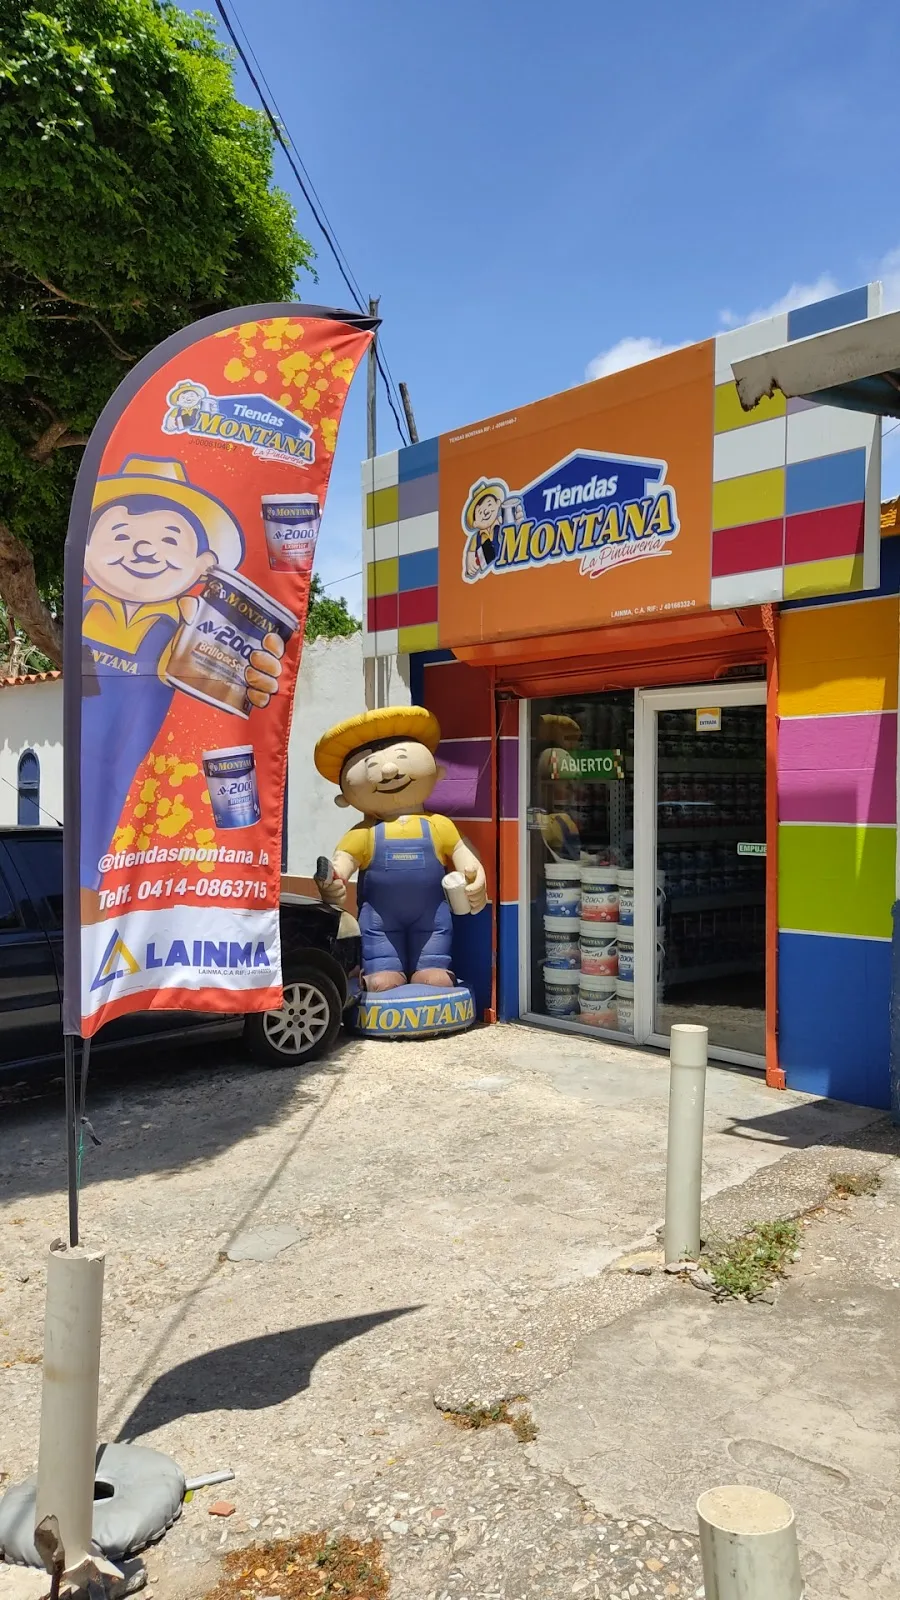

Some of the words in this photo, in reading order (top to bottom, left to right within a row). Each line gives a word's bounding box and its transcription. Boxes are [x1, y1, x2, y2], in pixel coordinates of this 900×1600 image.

[234, 403, 285, 427] Tiendas
[191, 411, 314, 461] MONTANA
[542, 475, 619, 512] Tiendas
[276, 508, 315, 516] MONTANA
[496, 493, 674, 567] MONTANA
[581, 555, 598, 572] La
[199, 642, 224, 660] Brillo
[560, 756, 613, 773] ABIERTO
[97, 845, 269, 873] @tiendasmontana_la
[98, 884, 132, 911] Telf.
[137, 878, 267, 901] 0414-0863715
[145, 939, 271, 970] LAINMA
[356, 997, 476, 1030] MONTANA
